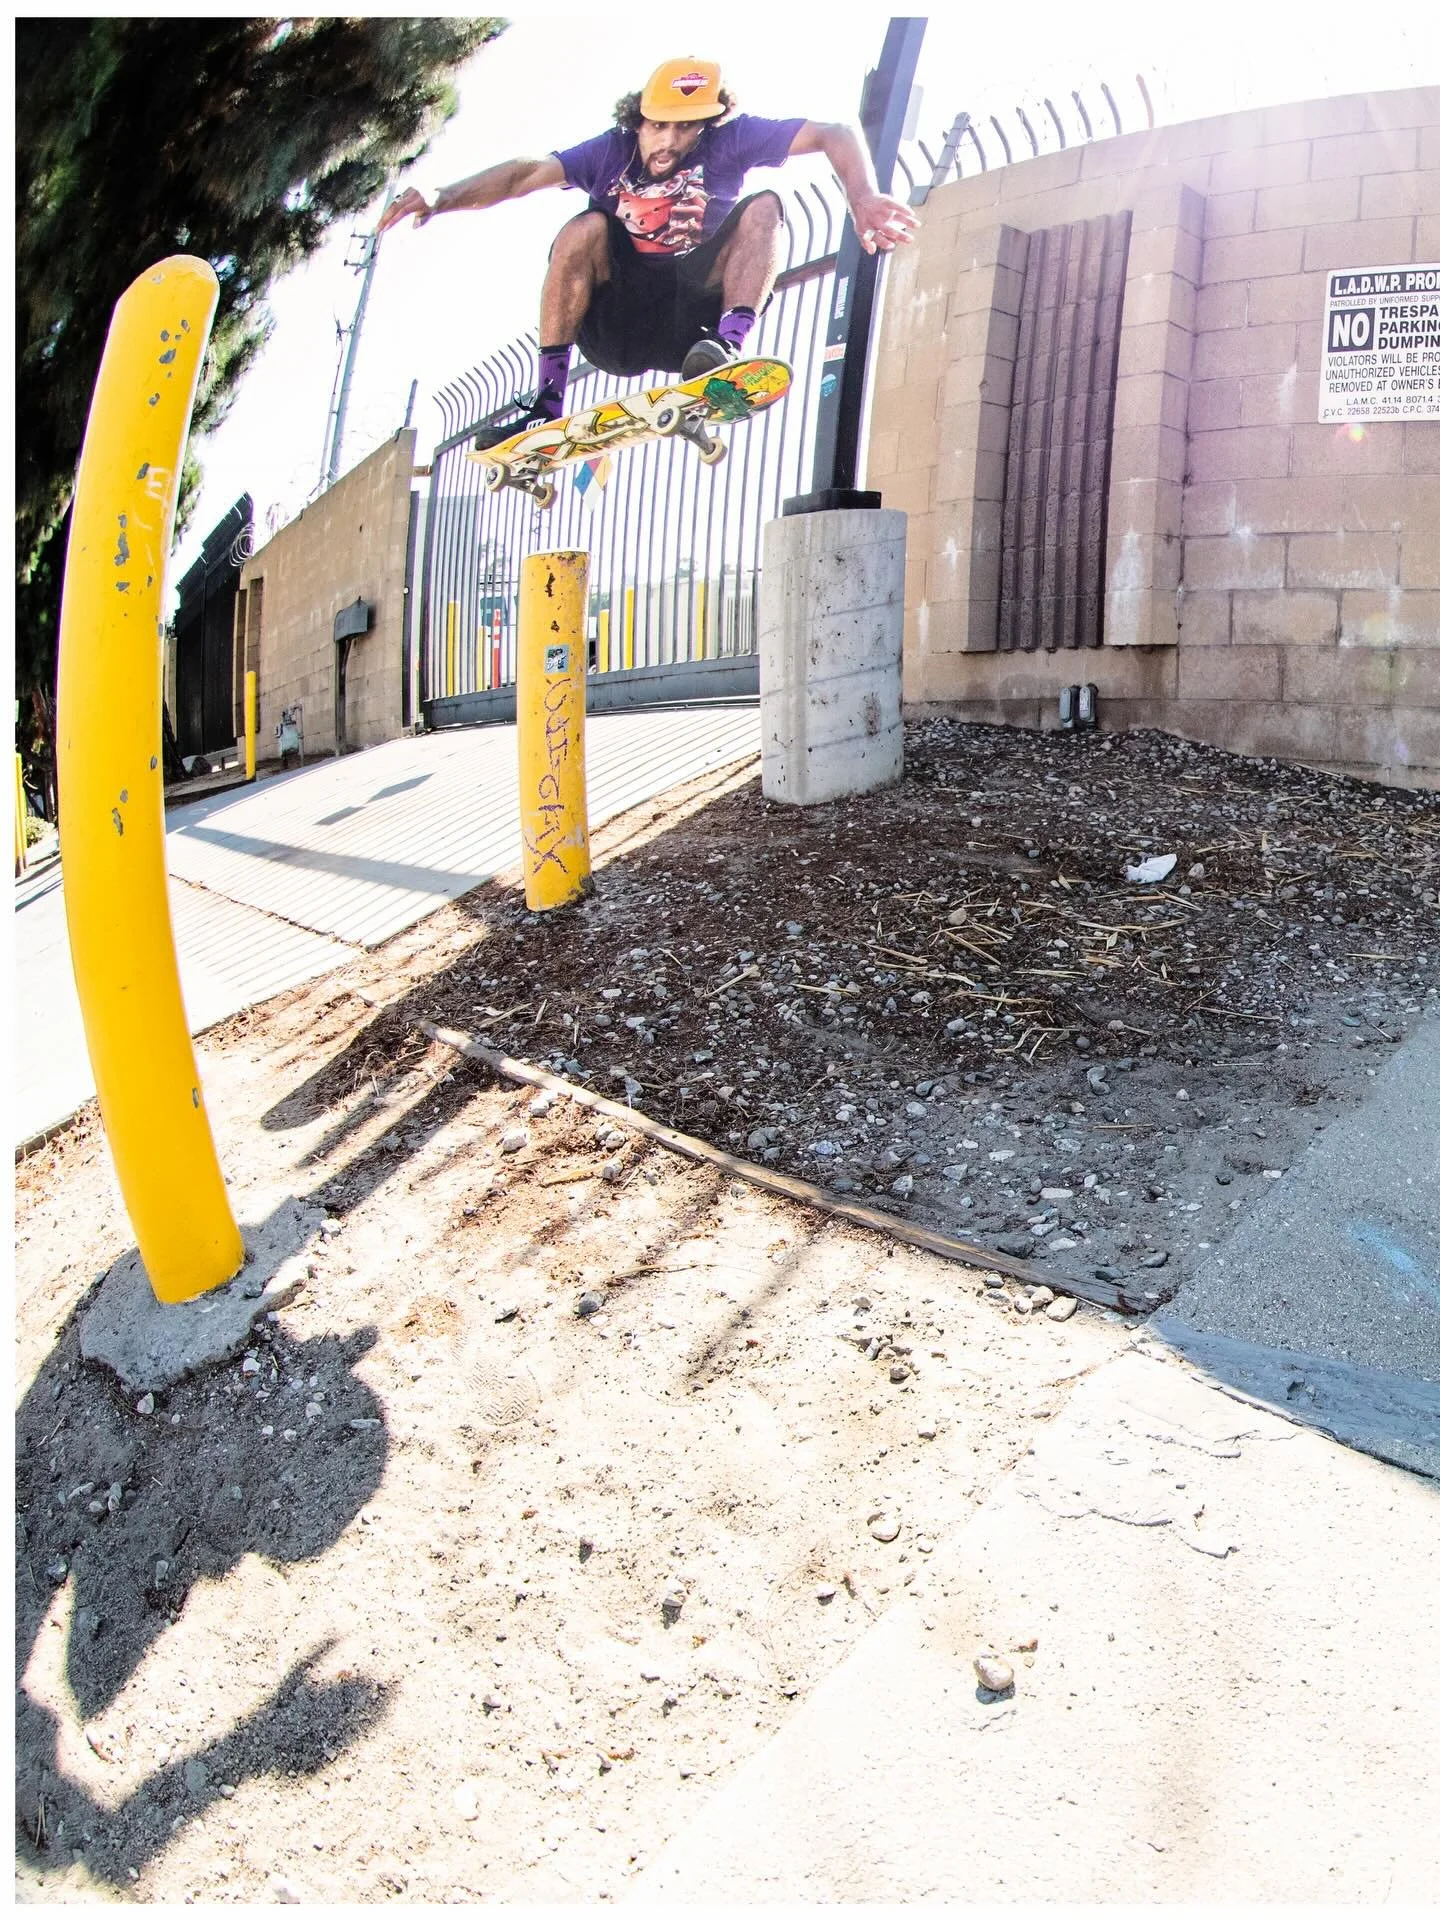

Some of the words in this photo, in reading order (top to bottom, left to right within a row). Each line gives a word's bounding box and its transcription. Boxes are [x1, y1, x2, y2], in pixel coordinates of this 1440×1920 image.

[1334, 274, 1401, 295] L.A.D.W.P.
[1330, 298, 1366, 307] PATROLLED
[1379, 295, 1418, 304] UNIFORMED
[1332, 312, 1370, 348] NO
[1379, 319, 1440, 334] PARKIN
[1328, 354, 1377, 367] VIOLATORS
[1381, 353, 1402, 364] WILL
[1406, 352, 1418, 363] BE
[1325, 366, 1395, 380] UNAUTHORIZED
[1329, 380, 1373, 393] REMOVED
[1376, 380, 1388, 391] AT
[1391, 378, 1434, 390] OWNER'S
